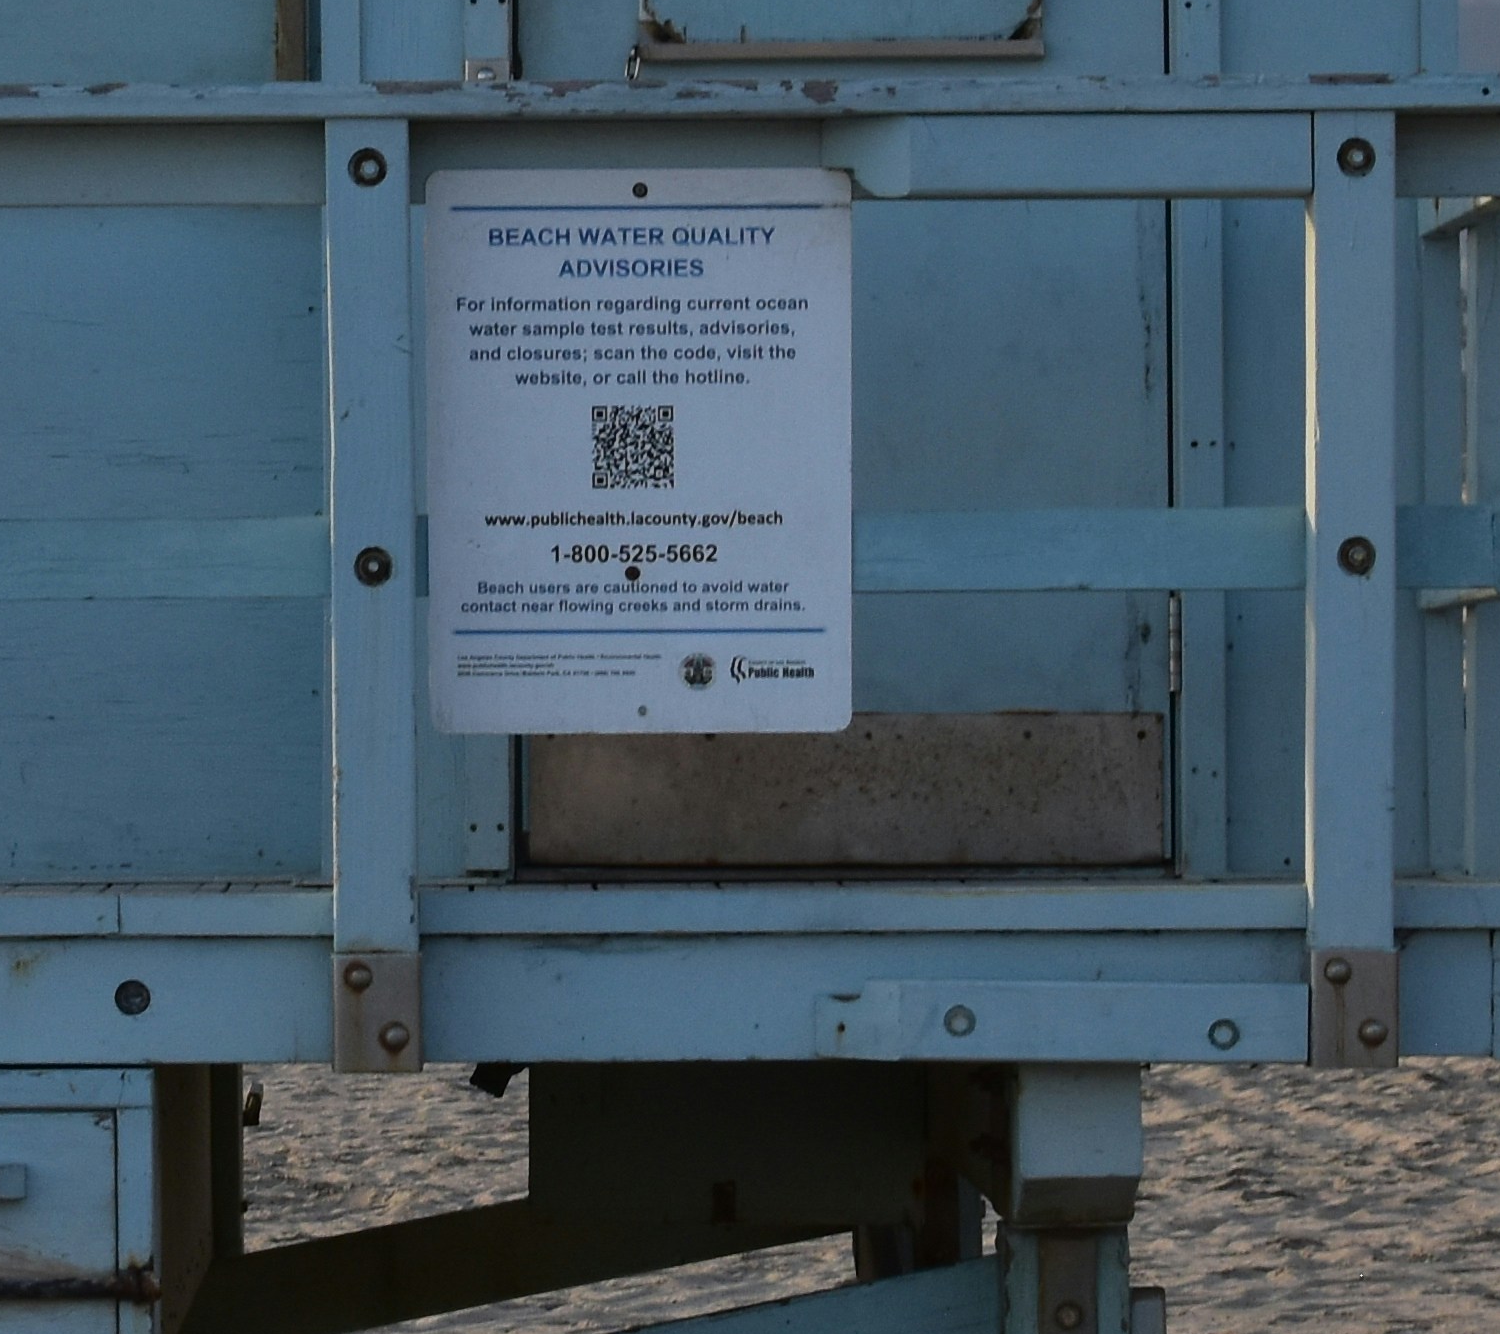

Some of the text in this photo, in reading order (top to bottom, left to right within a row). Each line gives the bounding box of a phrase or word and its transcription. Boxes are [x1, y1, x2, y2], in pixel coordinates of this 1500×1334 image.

[488, 226, 775, 247] BEACH WATER QUALITY
[558, 258, 704, 278] ADVISORIES
[455, 295, 809, 316] For information regarding current ocean
[468, 319, 795, 340] water sample test results, advisories,
[469, 344, 796, 363] and closures; scan the code, visit the
[514, 368, 750, 387] website, or call the hotline.
[484, 509, 783, 529] www.publichealth.lacounty.gov/beach
[551, 543, 718, 564] 1-800-525-5662
[476, 579, 789, 595] Beach users are cautioned to avoid water
[460, 598, 805, 616] contact near flowing creeks and storm drains.
[747, 666, 815, 679] Public Health
